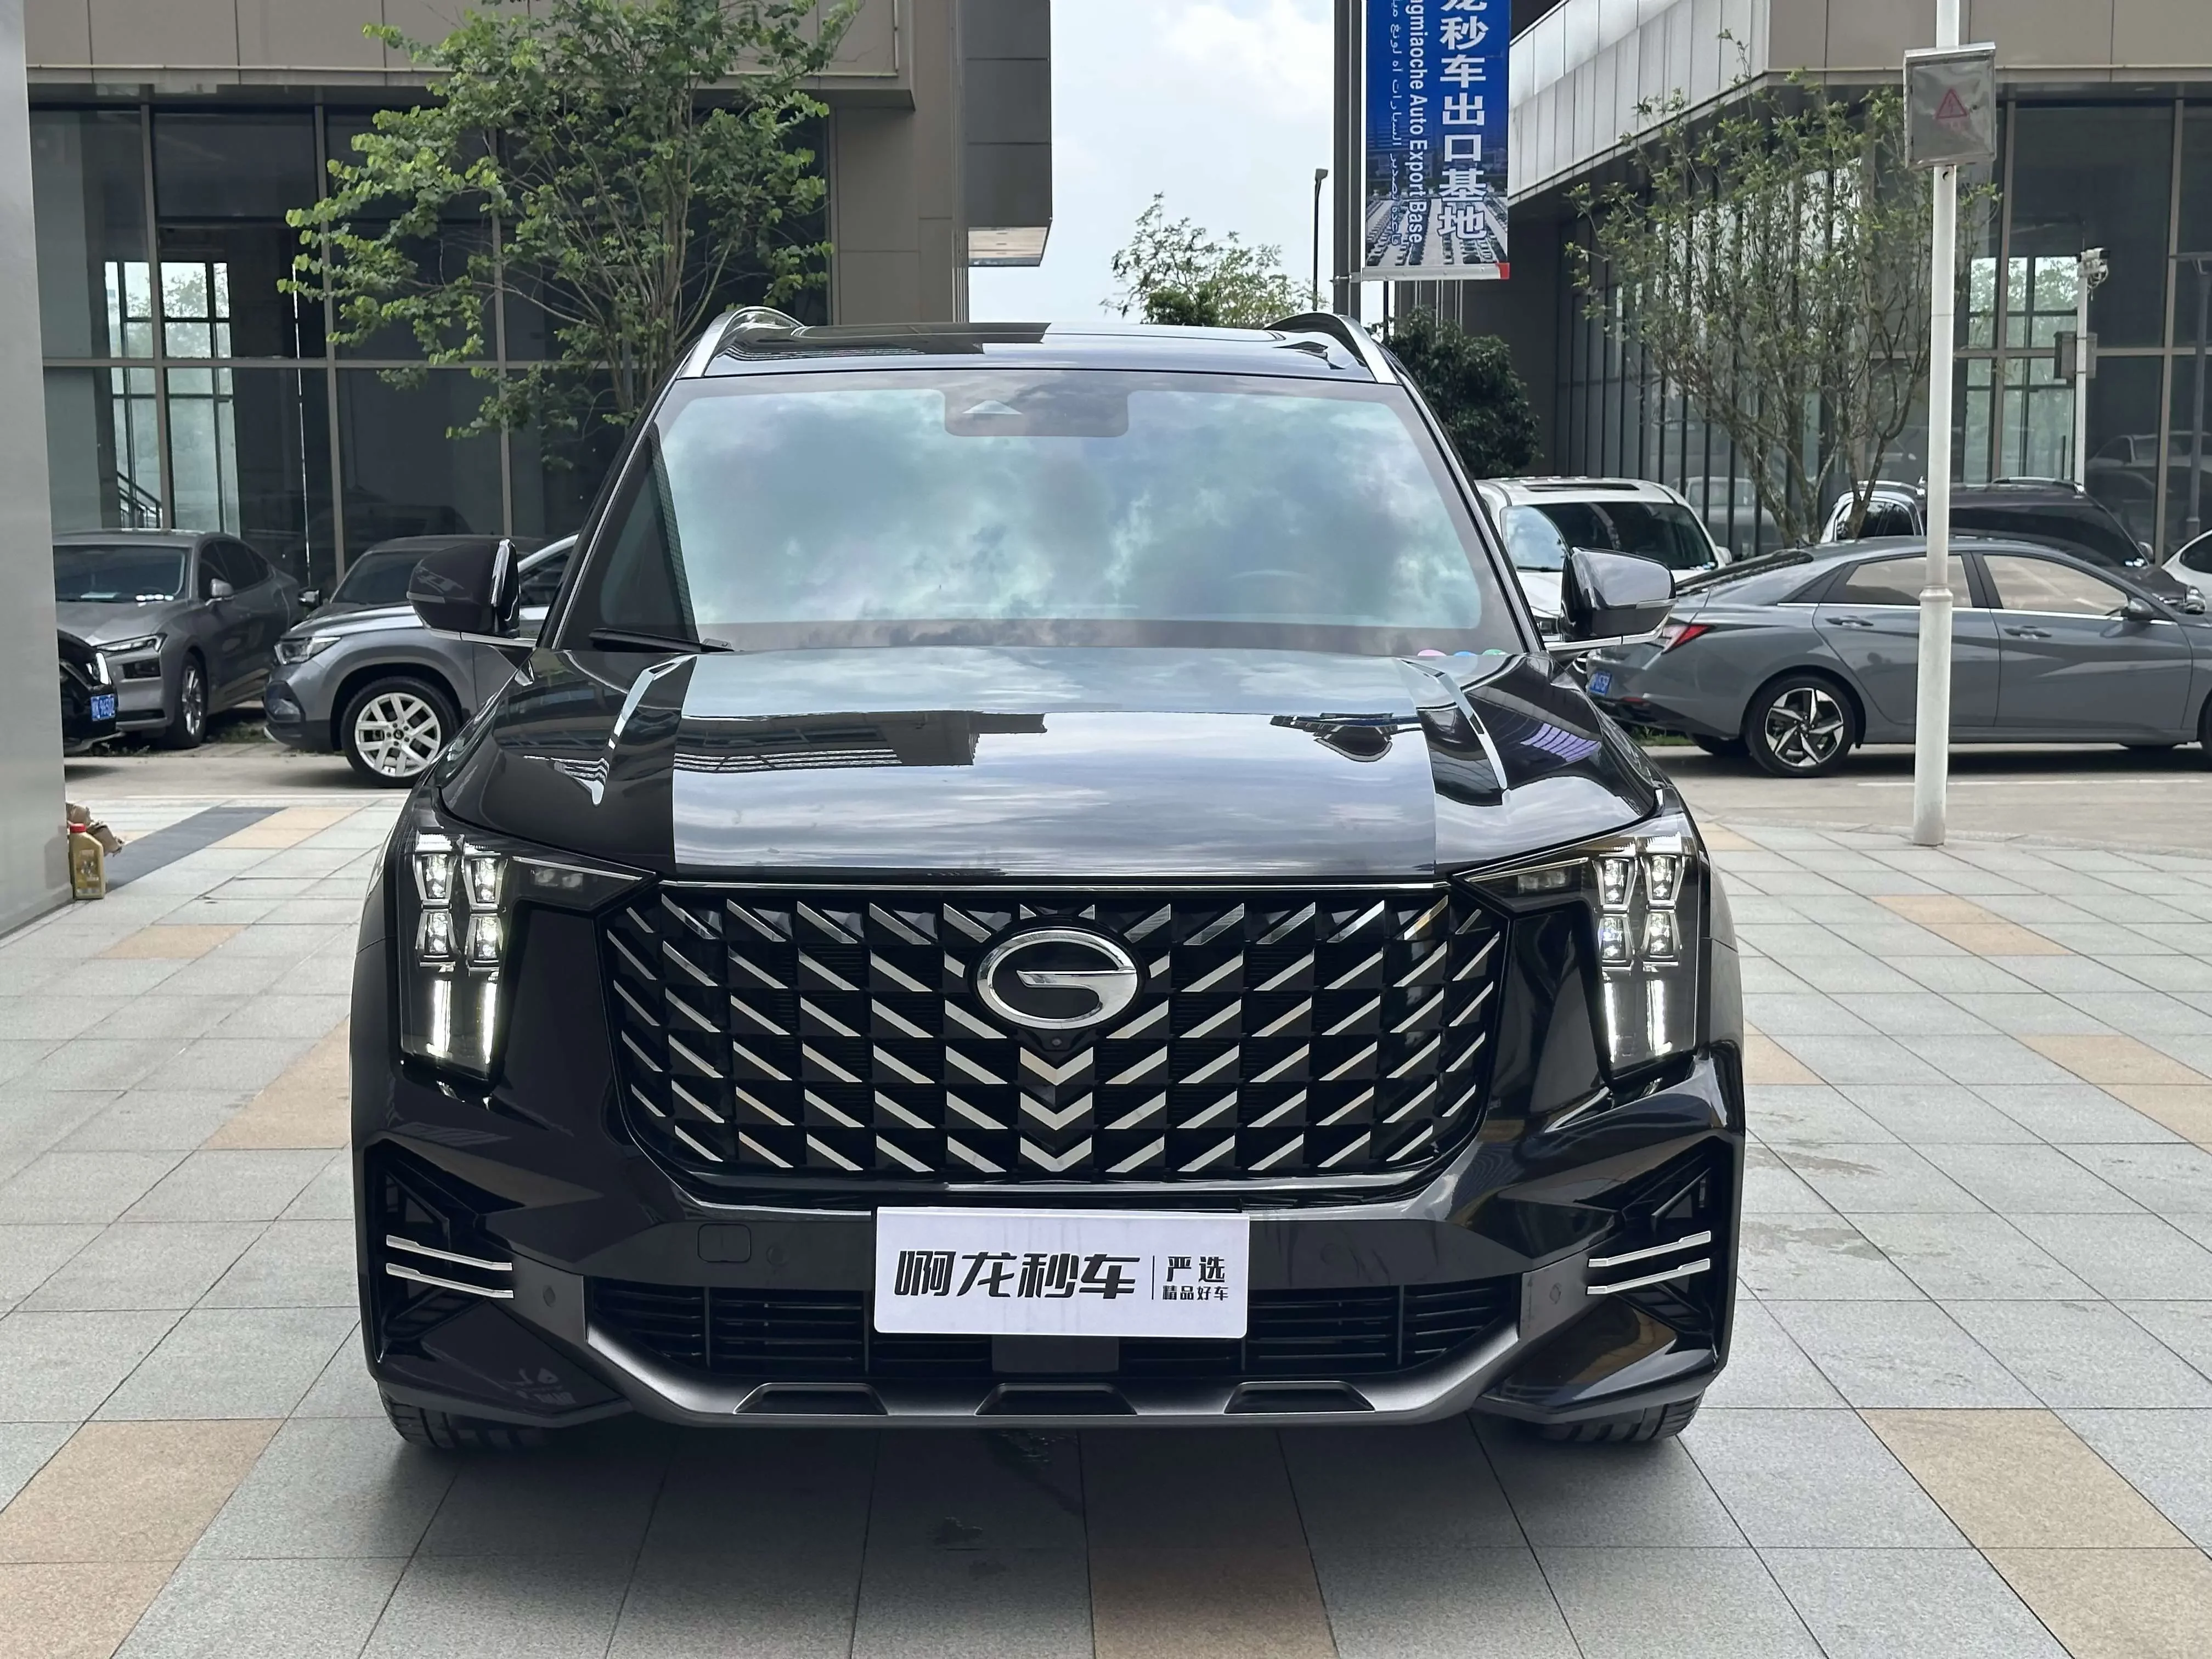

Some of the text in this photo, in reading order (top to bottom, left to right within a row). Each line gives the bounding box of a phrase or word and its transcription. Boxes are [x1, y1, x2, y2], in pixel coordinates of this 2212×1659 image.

[1390, 79, 1402, 145] السيارات
[1409, 94, 1427, 135] Auto
[1405, 139, 1427, 197] Export
[1409, 201, 1427, 243] Base
[894, 1250, 1225, 1299] 啊龙秒车 严选
[1163, 1285, 1229, 1301] 精品好车
